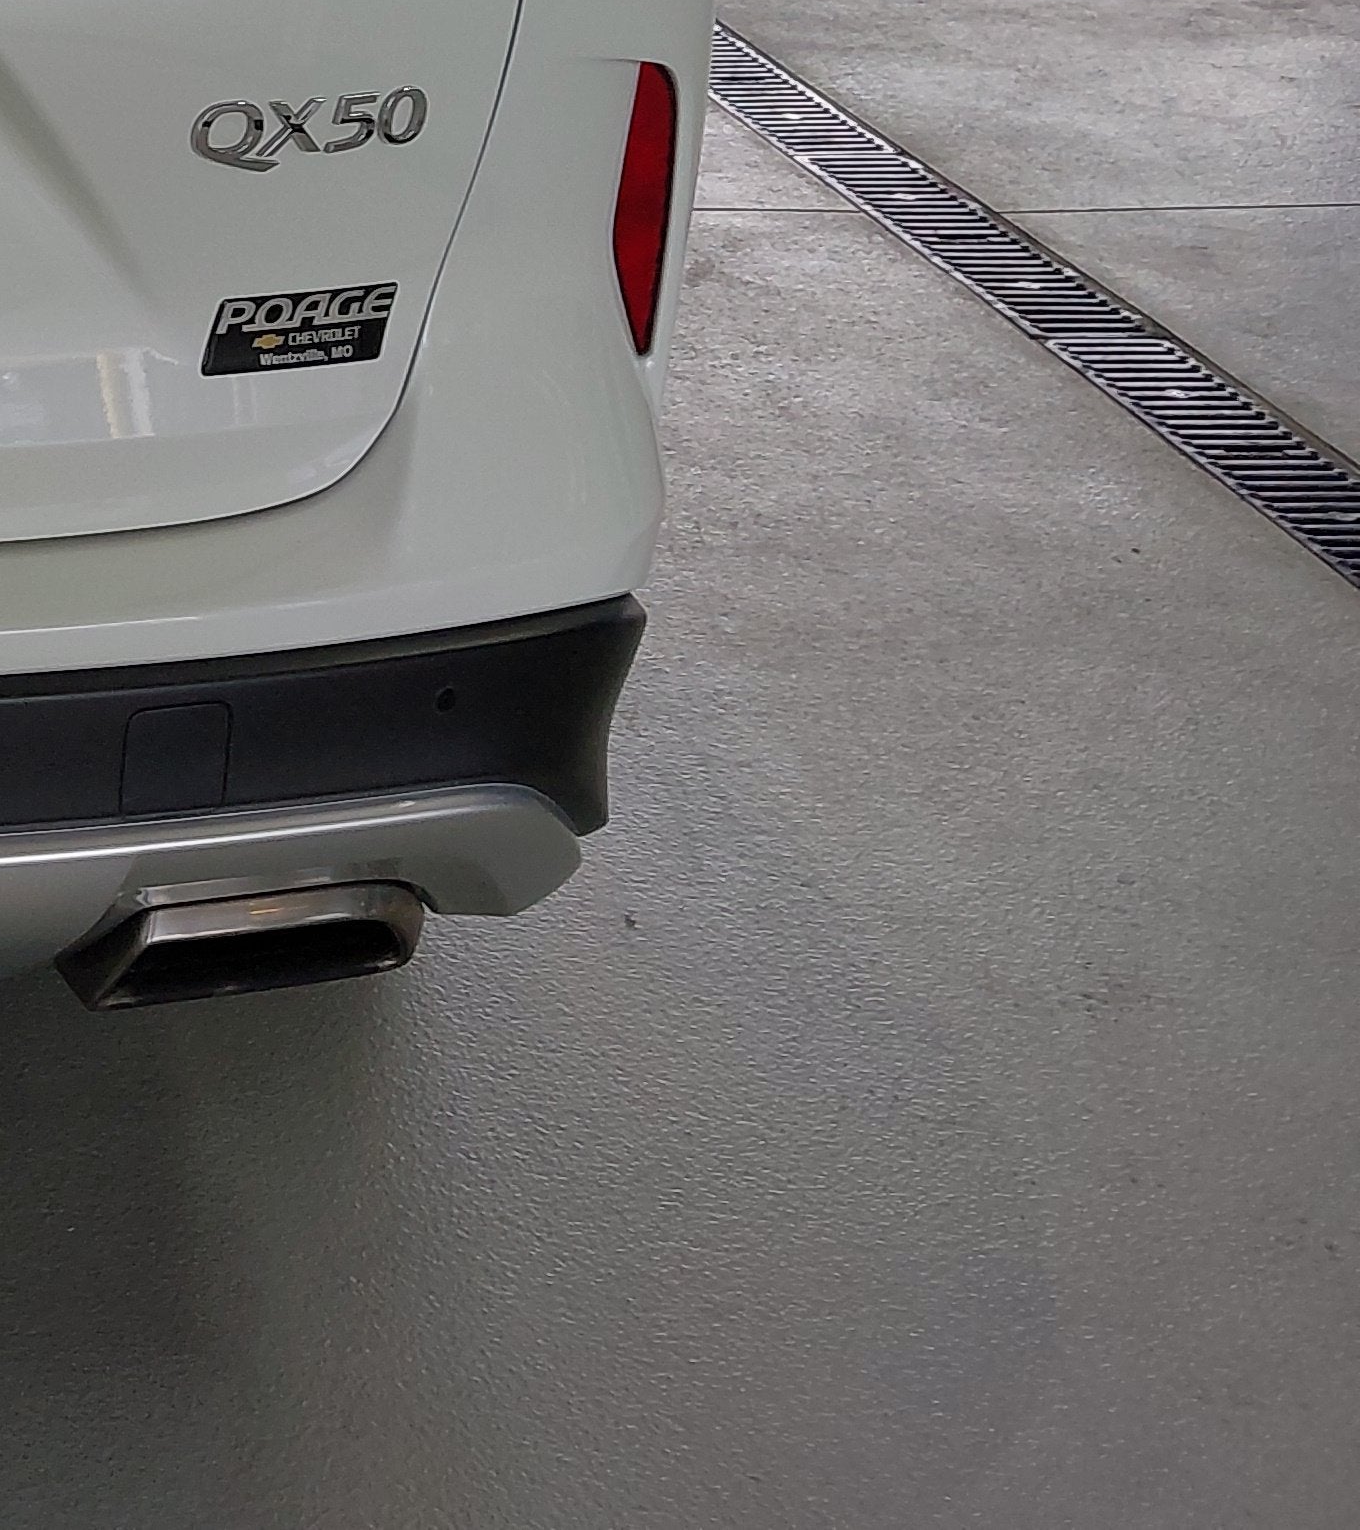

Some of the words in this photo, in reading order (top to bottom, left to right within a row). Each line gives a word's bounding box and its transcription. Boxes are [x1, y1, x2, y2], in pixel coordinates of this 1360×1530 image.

[191, 84, 428, 173] QX50
[215, 285, 397, 335] POAGE
[288, 325, 362, 346] CHEVROLET
[331, 344, 354, 359] MO
